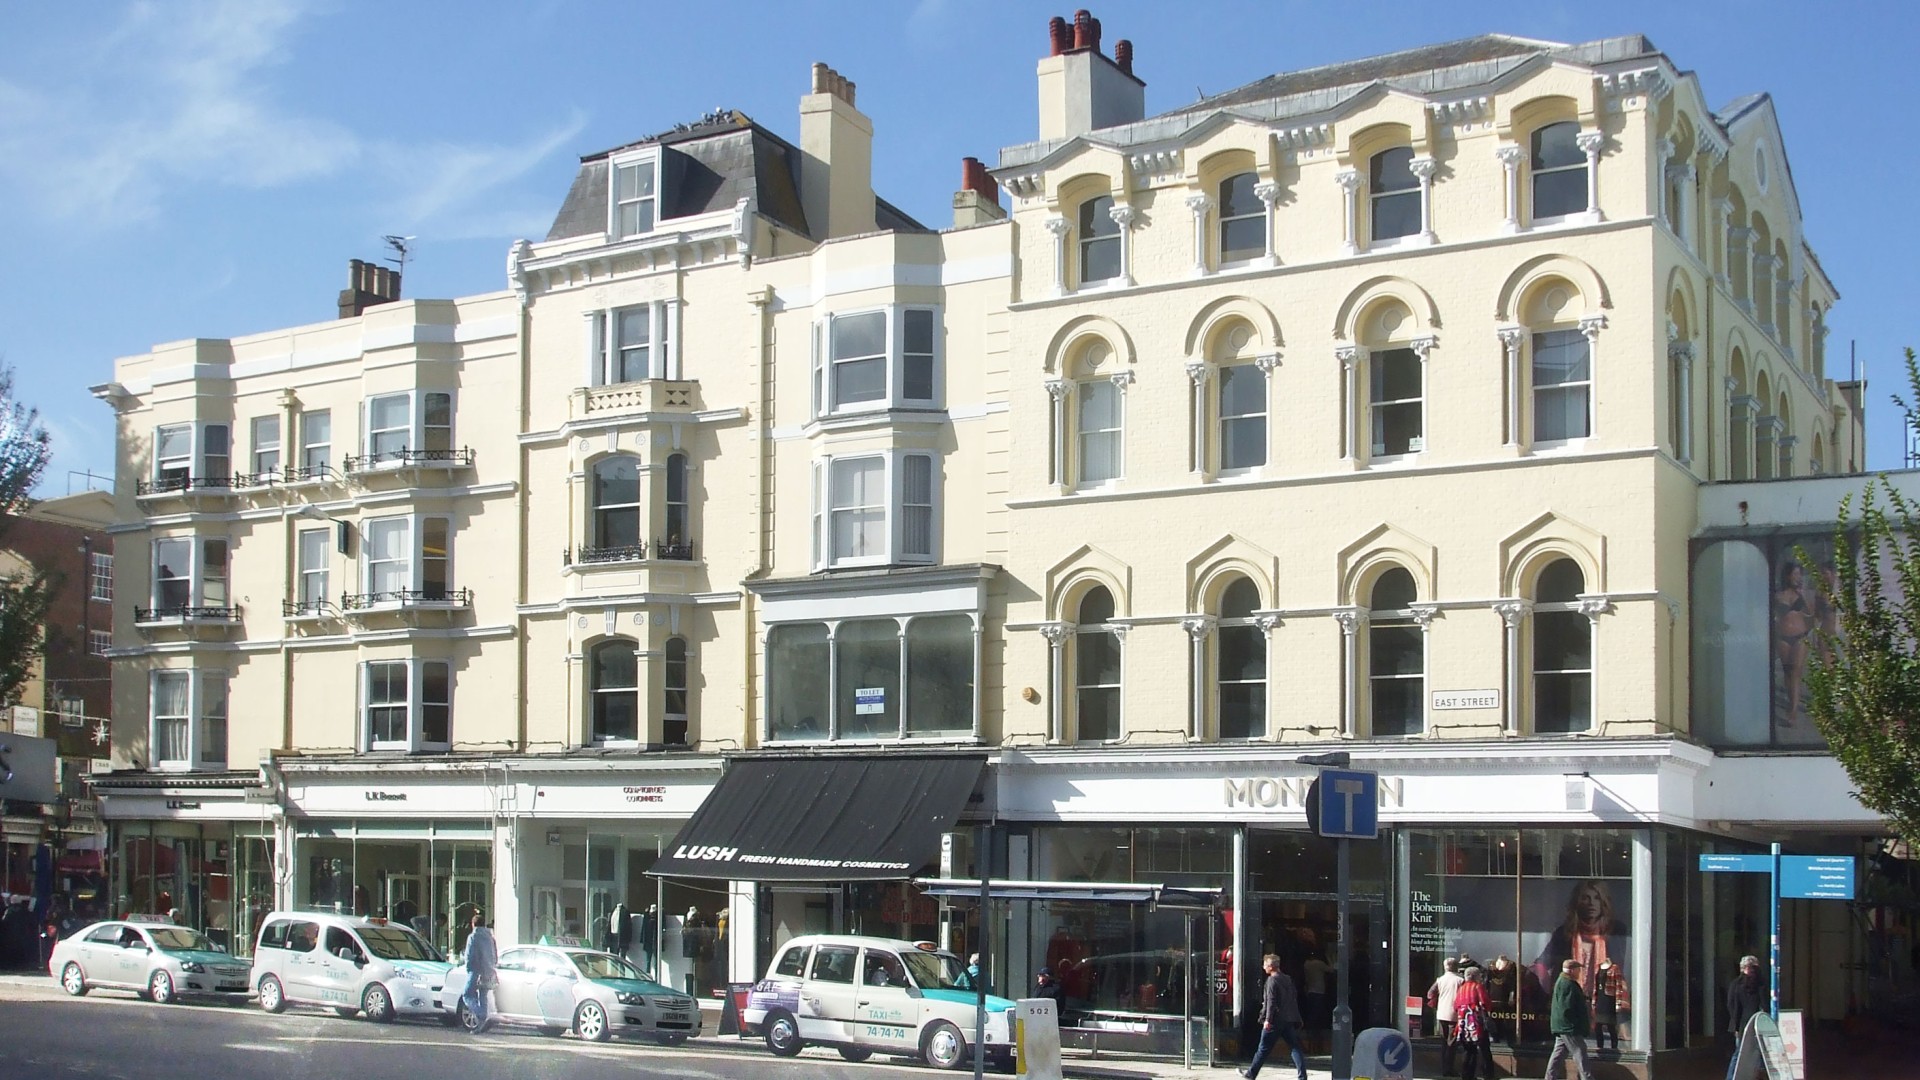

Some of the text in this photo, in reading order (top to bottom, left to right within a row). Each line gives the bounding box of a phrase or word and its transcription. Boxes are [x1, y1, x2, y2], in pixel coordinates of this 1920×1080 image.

[1435, 697, 1495, 707] EAST STREET
[1224, 776, 1404, 808] MONN
[673, 845, 738, 861] LUSH
[738, 855, 910, 869] FRESH HANDMADE COSMETICS
[1411, 890, 1431, 902] The
[1411, 901, 1457, 913] Bohemian
[1411, 912, 1433, 923] Knit
[868, 1009, 888, 1019] TAXI
[1030, 1007, 1049, 1015] 502
